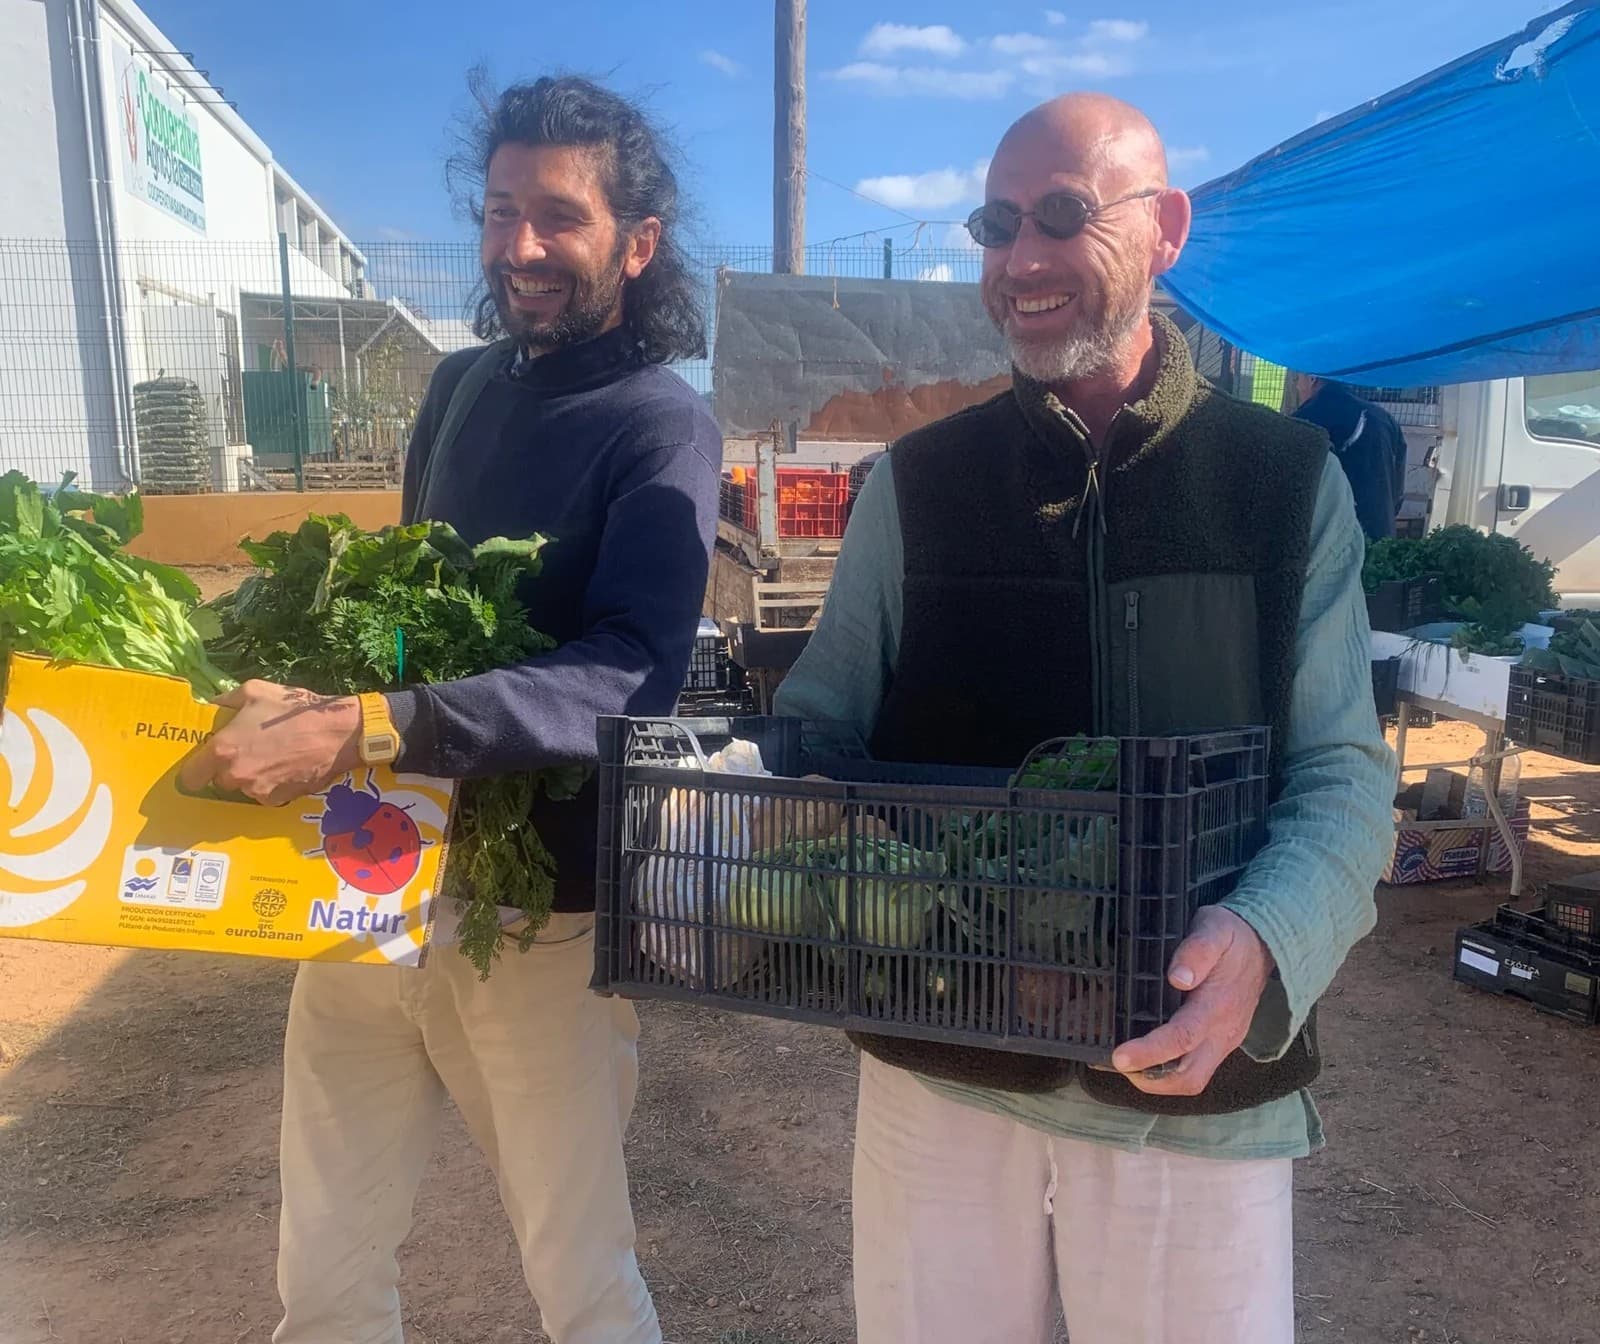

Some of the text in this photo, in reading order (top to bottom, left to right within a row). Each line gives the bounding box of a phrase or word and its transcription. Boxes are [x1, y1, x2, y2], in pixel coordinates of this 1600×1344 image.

[139, 70, 201, 168] Cooperativa
[225, 926, 304, 942] eurobanan
[310, 900, 407, 934] Natur
